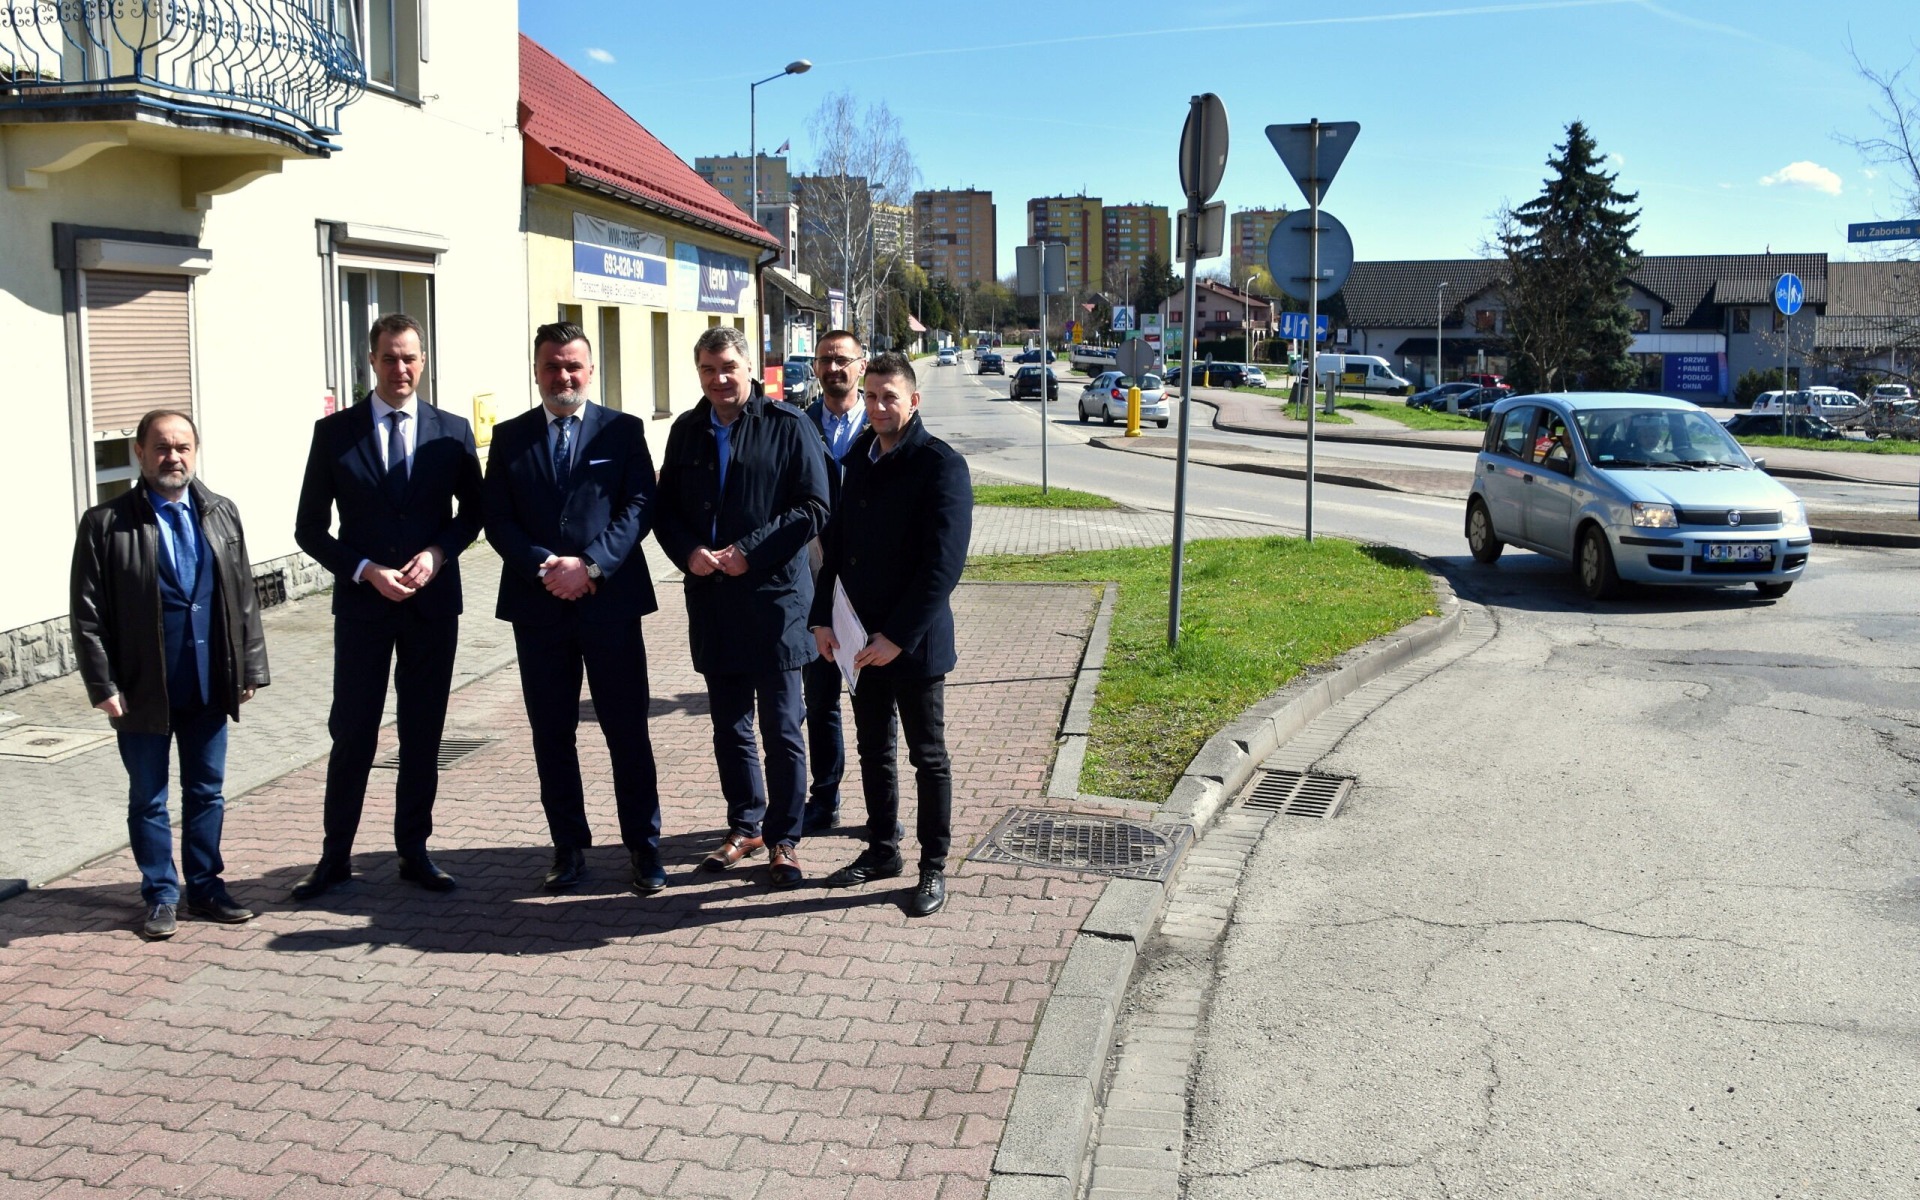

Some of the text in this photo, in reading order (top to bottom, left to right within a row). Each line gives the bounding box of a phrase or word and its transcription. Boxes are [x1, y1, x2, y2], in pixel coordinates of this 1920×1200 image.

[608, 227, 640, 250] WW-TRANS
[1856, 226, 1911, 237] ul. Zaborska
[604, 252, 644, 279] 693-820-190
